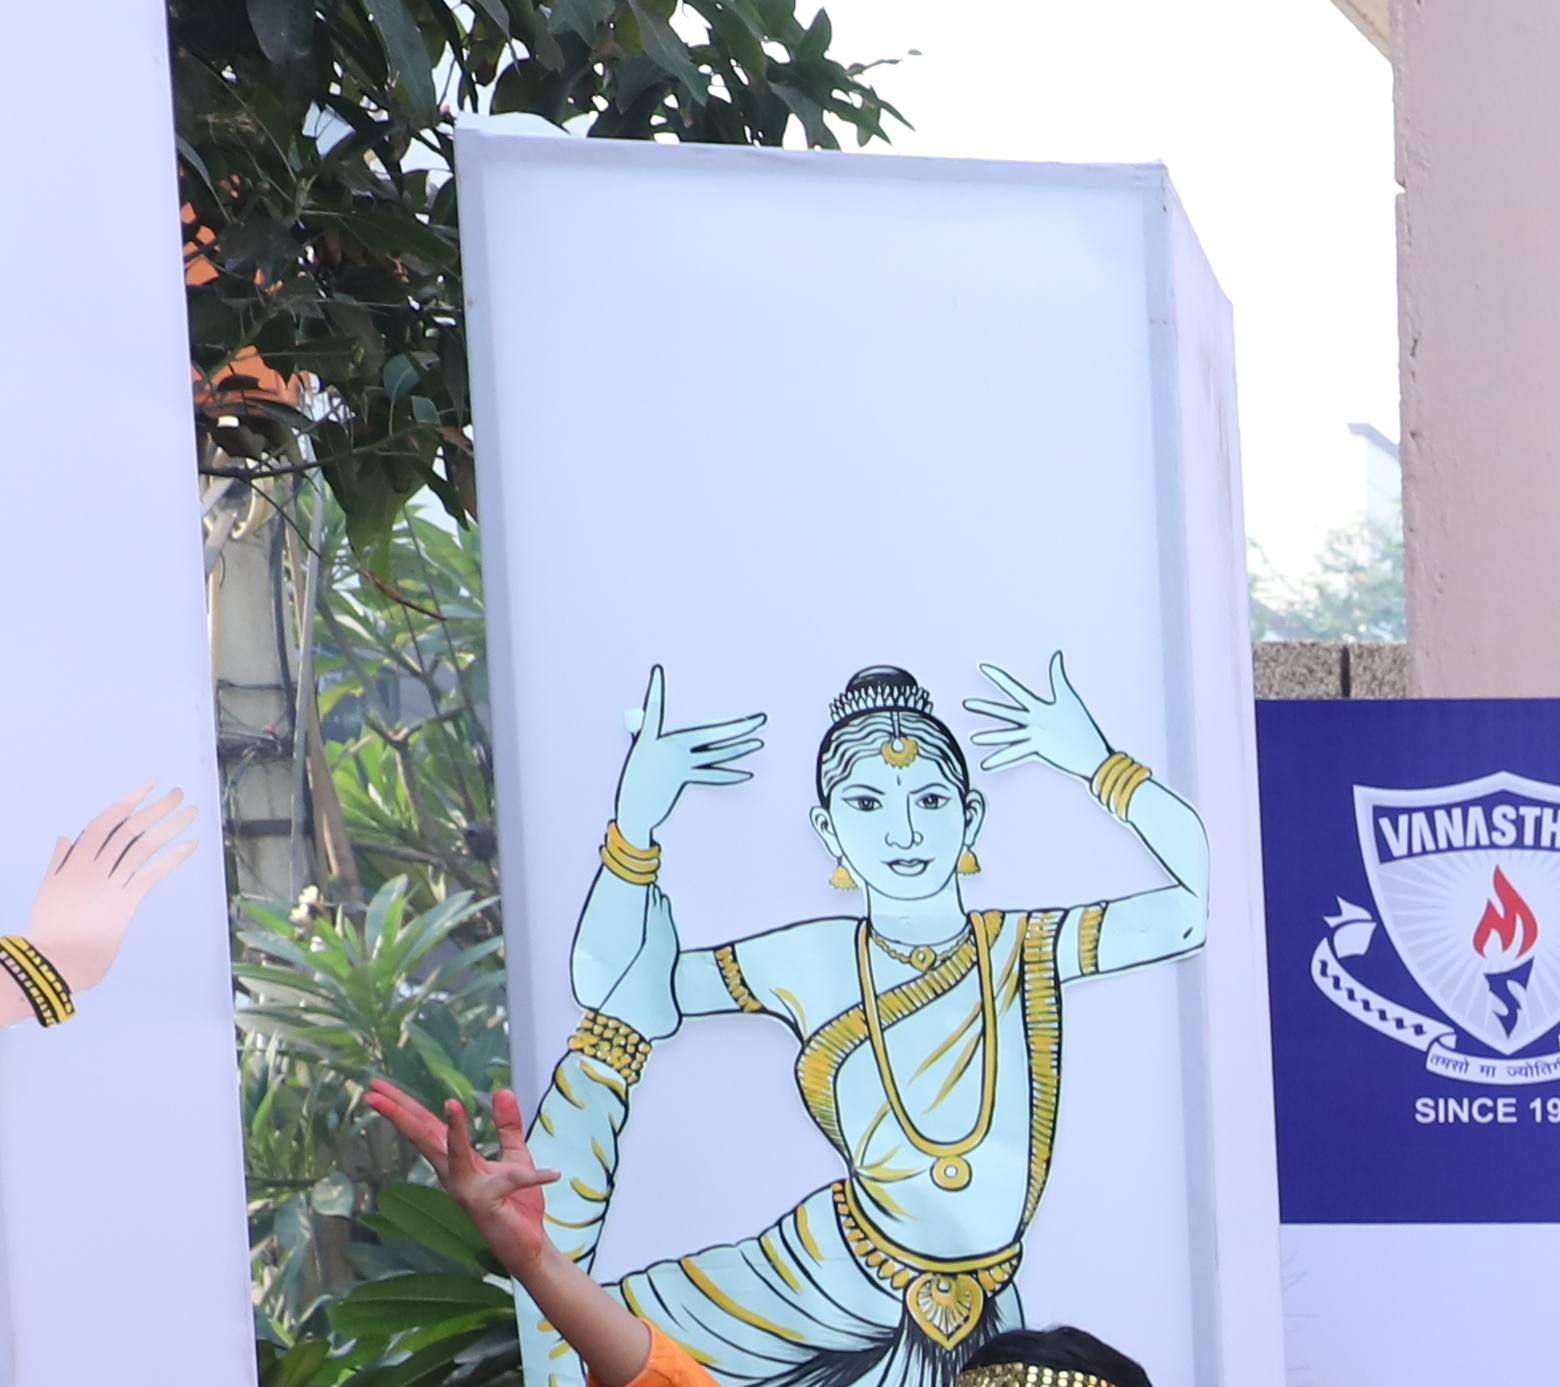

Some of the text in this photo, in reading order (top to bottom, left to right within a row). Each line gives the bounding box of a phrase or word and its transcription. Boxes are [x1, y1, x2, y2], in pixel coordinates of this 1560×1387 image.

[1430, 1053, 1469, 1075] तमसो
[1479, 1063, 1496, 1079] मा
[1415, 1097, 1517, 1124] SINCE
